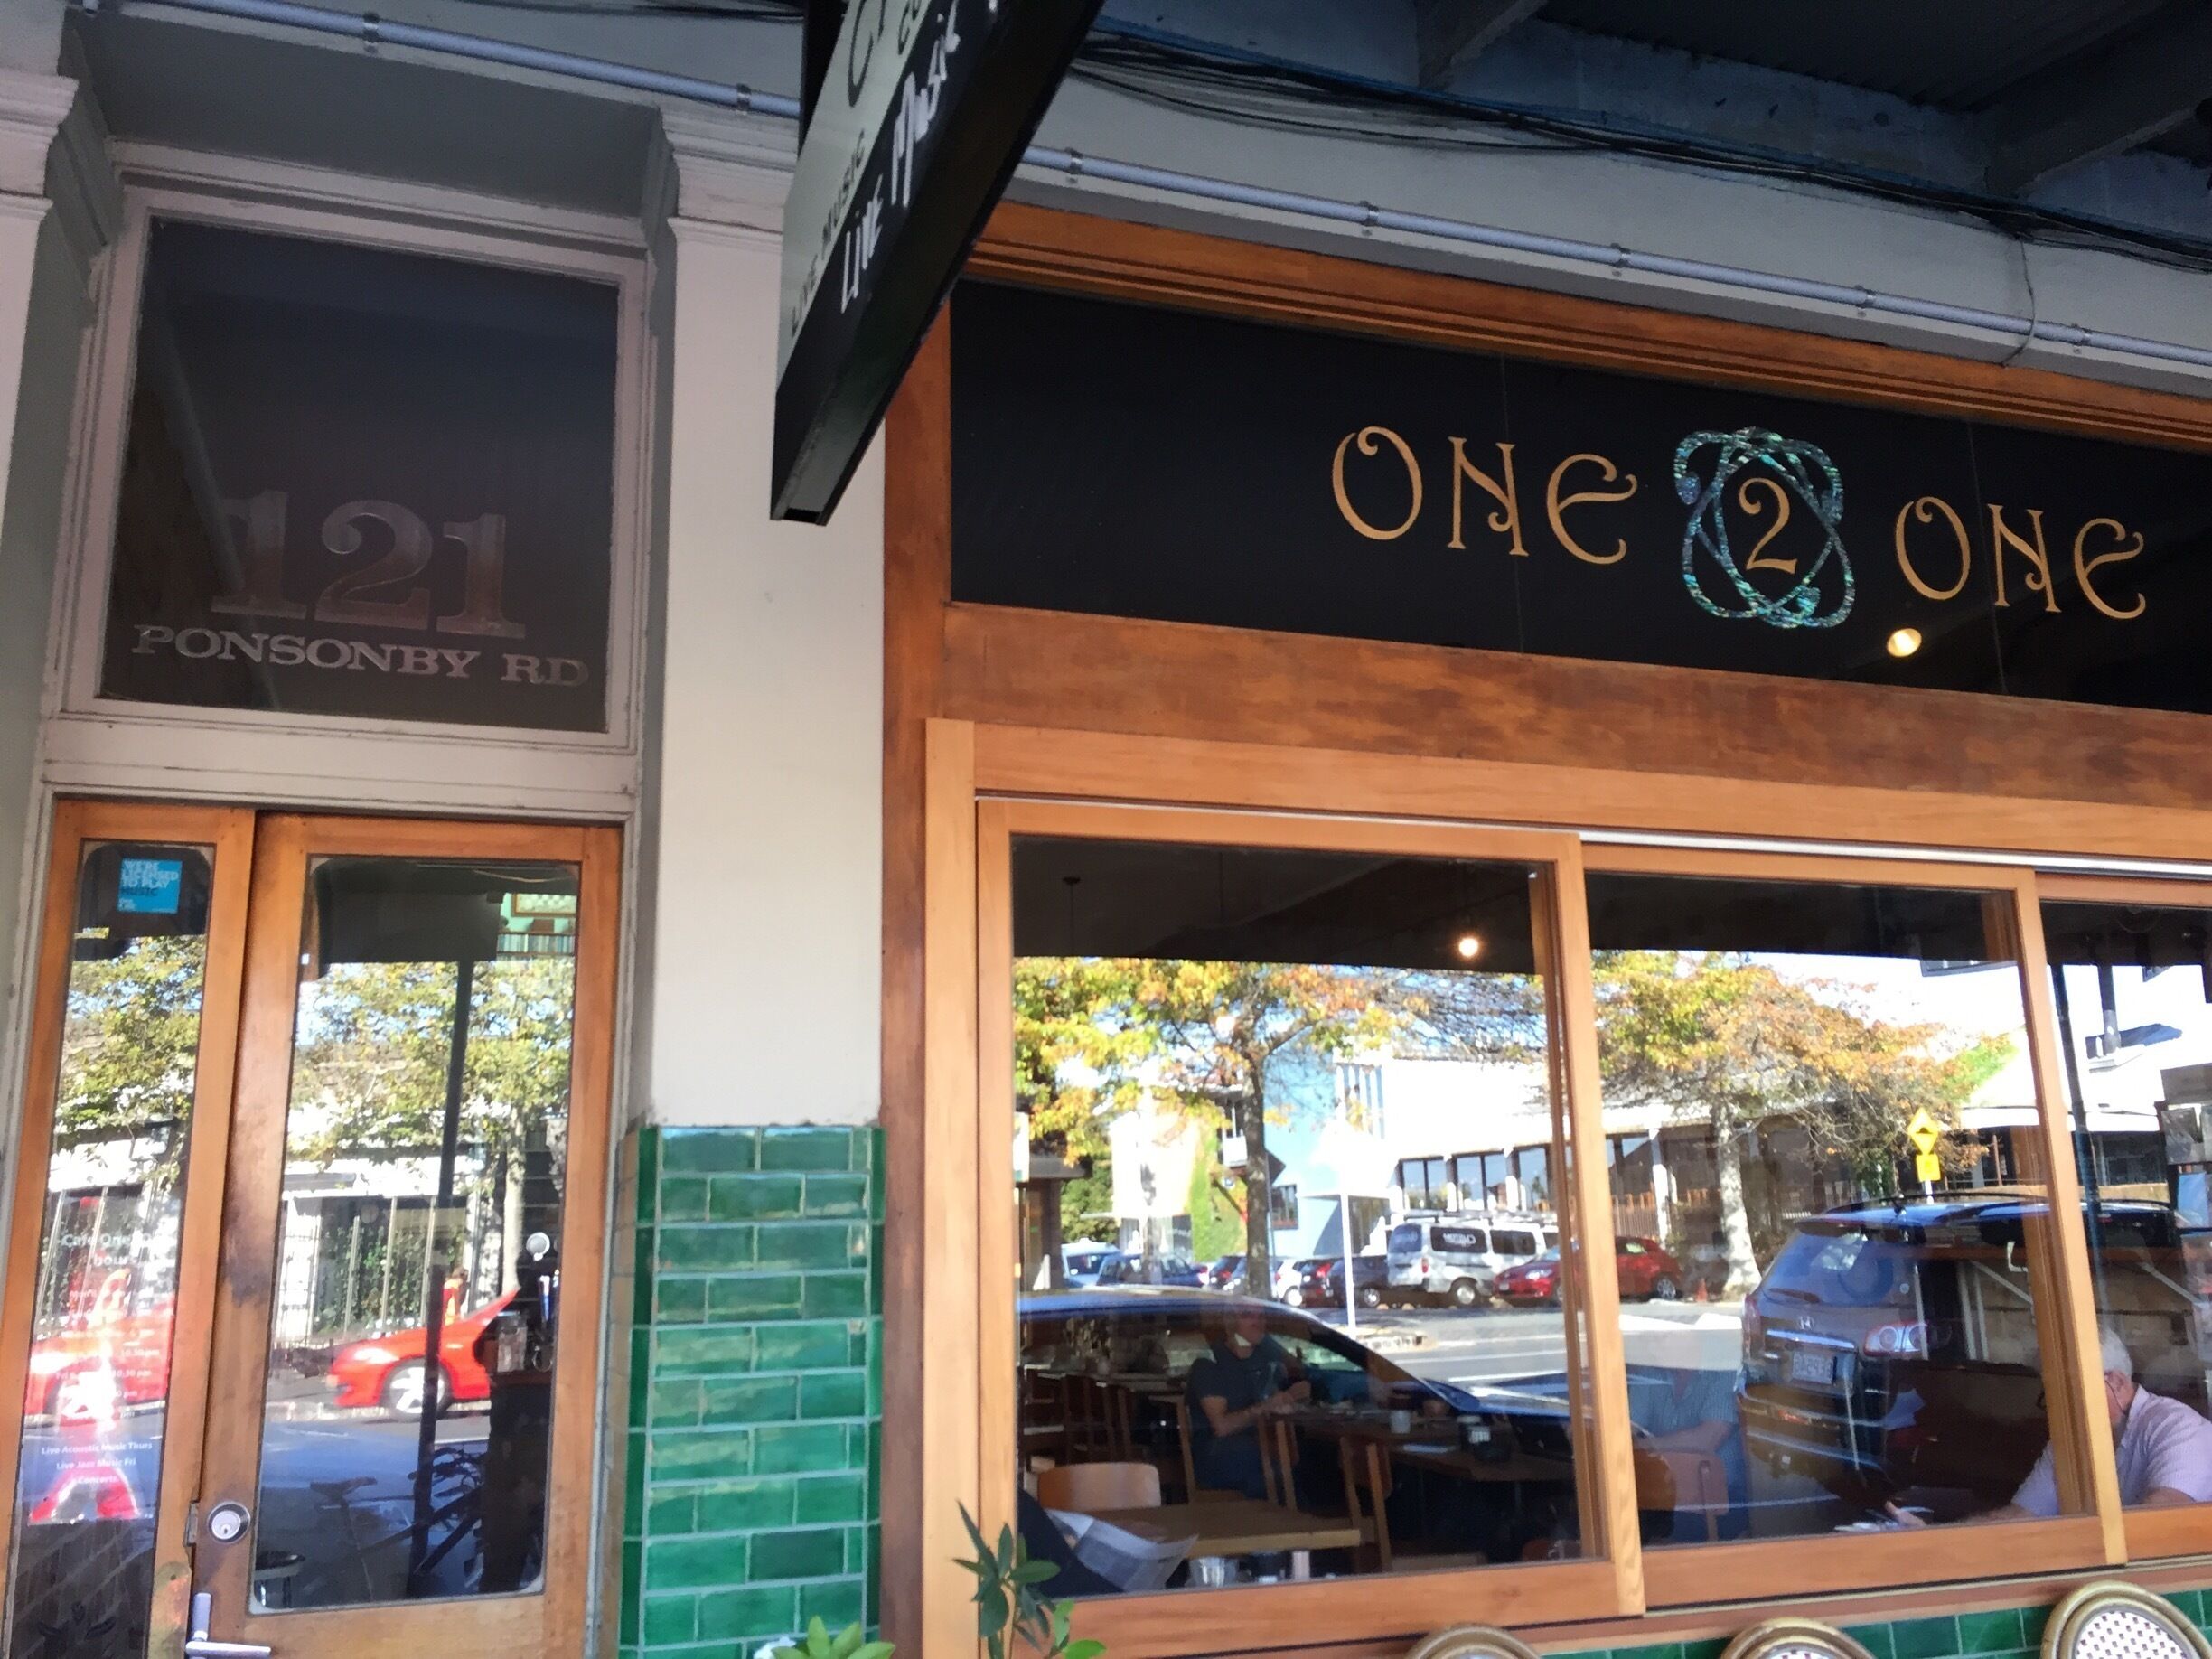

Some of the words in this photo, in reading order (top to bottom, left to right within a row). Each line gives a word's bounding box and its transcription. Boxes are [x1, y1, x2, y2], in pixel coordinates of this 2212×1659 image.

[822, 129, 865, 260] MUSIC
[211, 490, 526, 640] 121
[1332, 425, 1638, 565] ONE
[1737, 476, 1797, 575] 2
[1894, 495, 2148, 620] ONE
[132, 623, 481, 679] PONSONBY
[501, 652, 589, 688] RD
[42, 1447, 61, 1455] Live
[61, 1444, 99, 1455] Acoustic
[101, 1442, 127, 1451] Music
[128, 1441, 153, 1450] Thurs
[57, 1462, 74, 1470] Live
